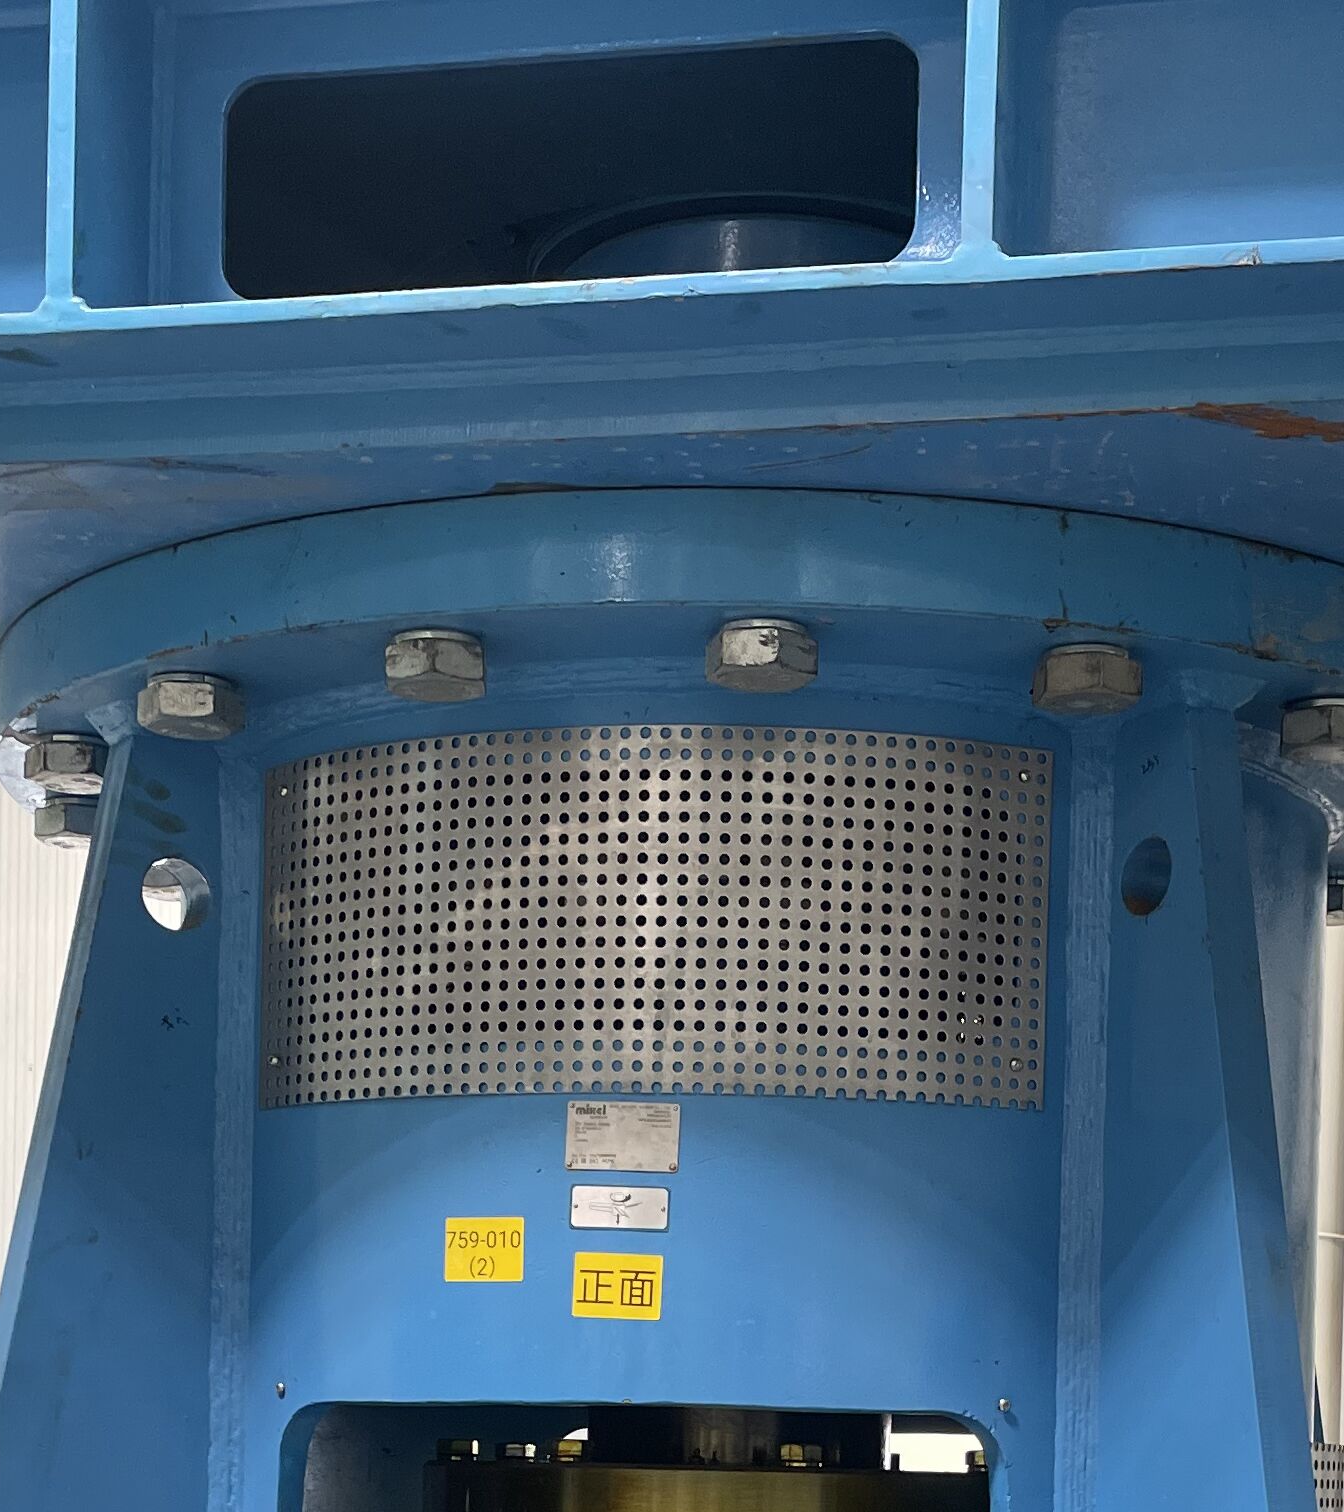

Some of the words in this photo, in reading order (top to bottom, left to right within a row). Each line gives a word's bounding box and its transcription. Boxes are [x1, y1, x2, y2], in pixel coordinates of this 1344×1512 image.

[446, 1230, 521, 1249] 759-010
[469, 1255, 496, 1279] (2)
[576, 1269, 657, 1307] 正面
